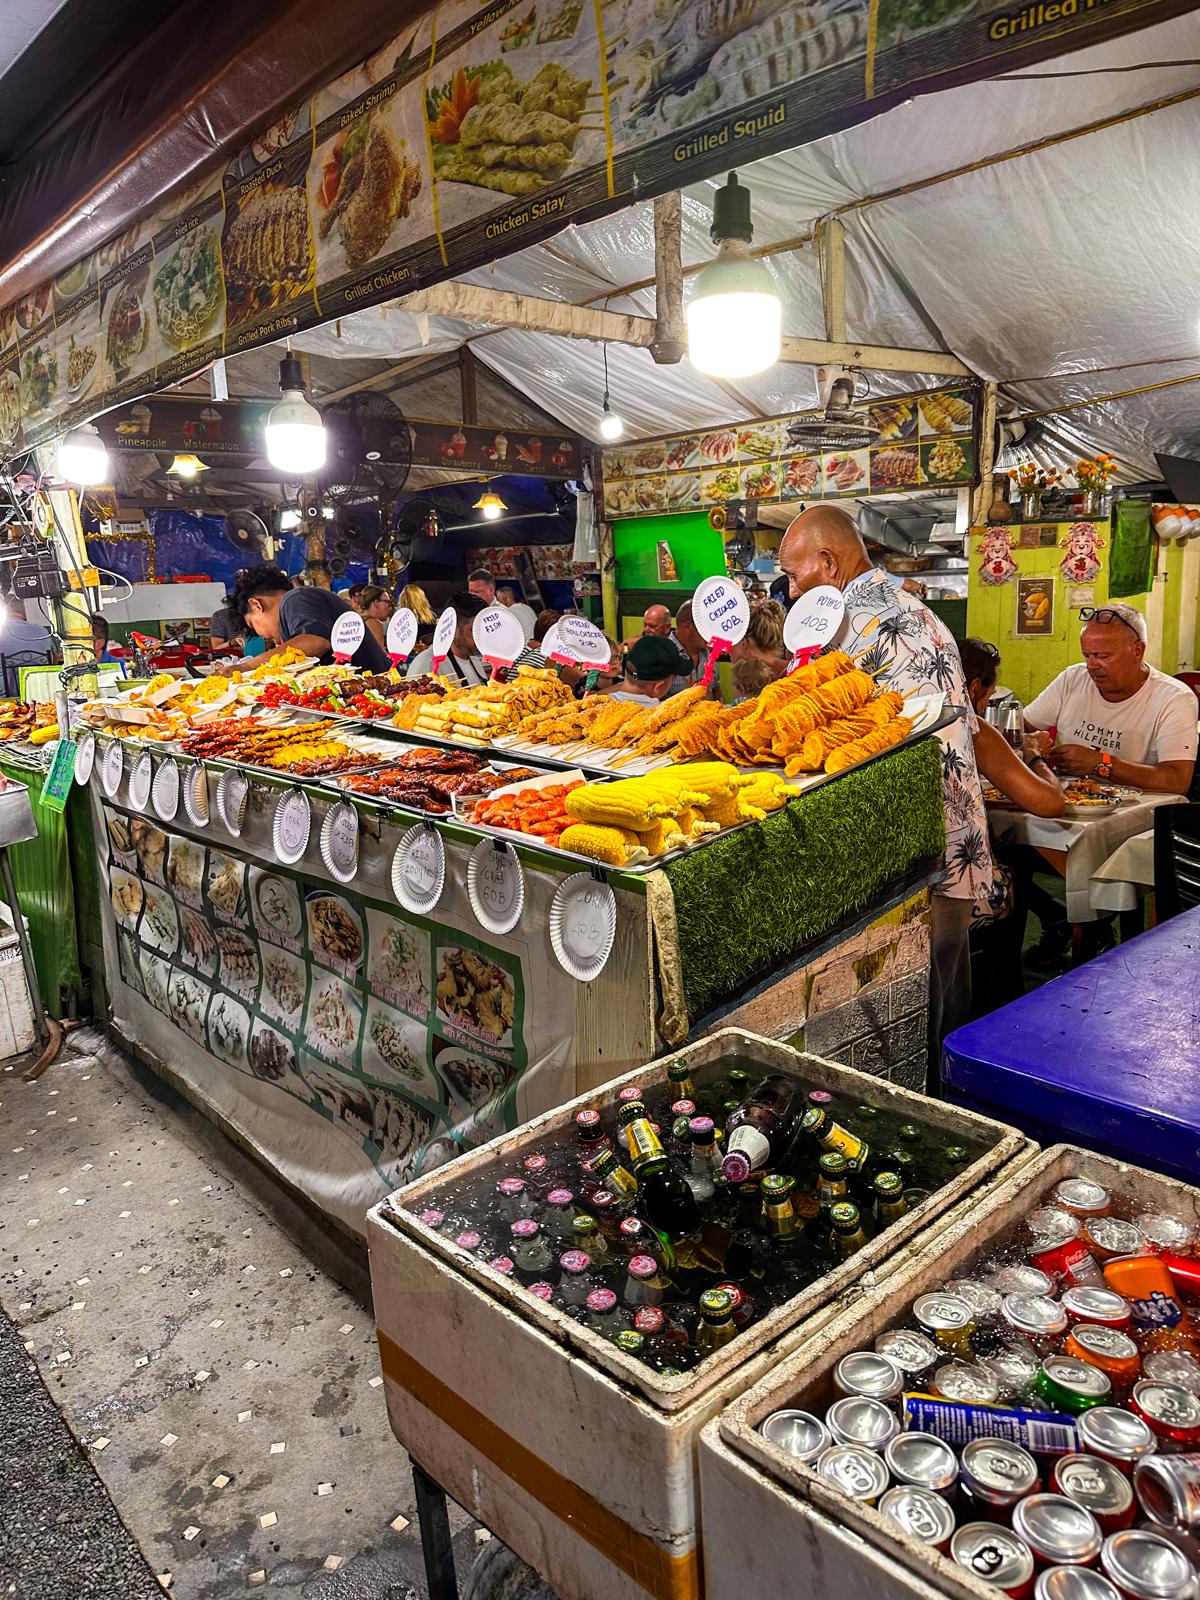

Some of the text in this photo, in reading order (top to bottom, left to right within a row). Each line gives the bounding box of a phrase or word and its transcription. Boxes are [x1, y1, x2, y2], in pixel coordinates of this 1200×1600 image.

[470, 5, 506, 34] Yellow
[990, 0, 1077, 40] Grilled
[340, 81, 397, 127] Baked Shrimp
[673, 103, 785, 161] Grilled Squid
[239, 162, 284, 196] Roasted Duck
[189, 216, 202, 229] rice
[484, 194, 567, 240] Chicken Satay
[344, 267, 410, 302] Grilled Chicken
[237, 316, 292, 346] Grilled Pork Ribs
[118, 435, 167, 448] Pineapple
[441, 457, 481, 469] Strawberry
[703, 586, 725, 607] FRIED
[816, 595, 842, 610] POTATO
[483, 613, 500, 623] FRIED
[709, 598, 738, 621] CHICKEN
[485, 621, 502, 633] FISH
[1073, 728, 1121, 750] HILFIGER
[1081, 720, 1123, 740] TOMMY
[411, 848, 430, 861] RIBS
[480, 1027, 497, 1045] Fish
[482, 1046, 512, 1061] seeds
